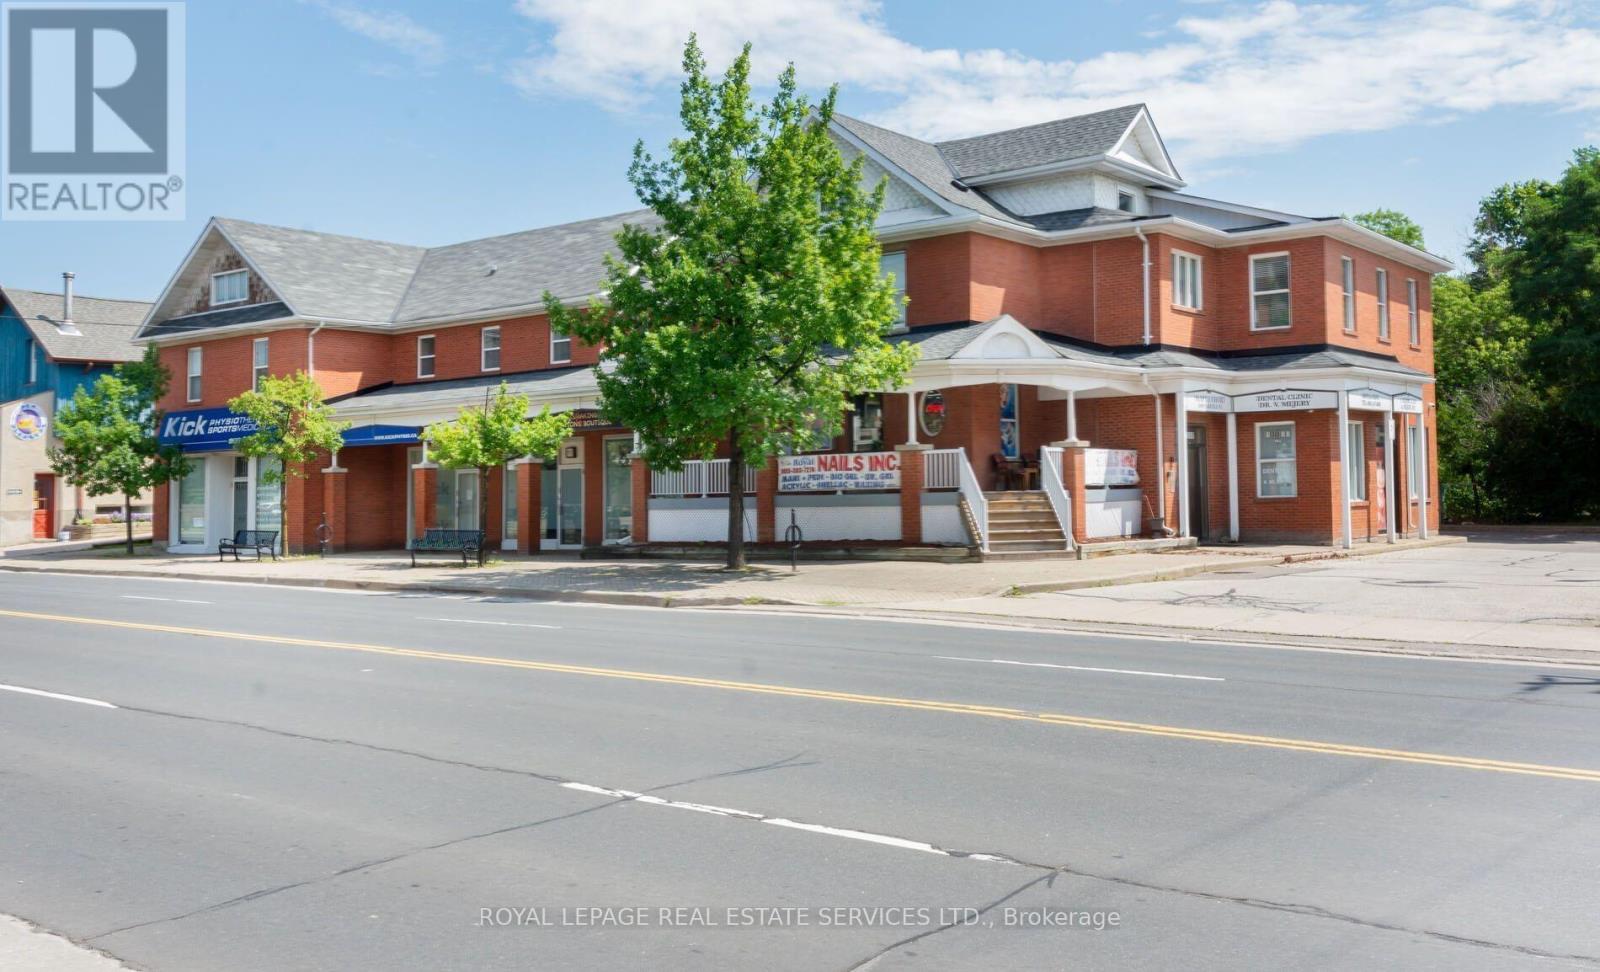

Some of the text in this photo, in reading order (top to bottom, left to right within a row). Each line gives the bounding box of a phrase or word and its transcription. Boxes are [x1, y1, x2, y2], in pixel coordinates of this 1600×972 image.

[1256, 394, 1286, 402] DENTAL
[164, 415, 208, 438] Kick
[817, 454, 864, 472] NAILS
[868, 453, 901, 471] INC.
